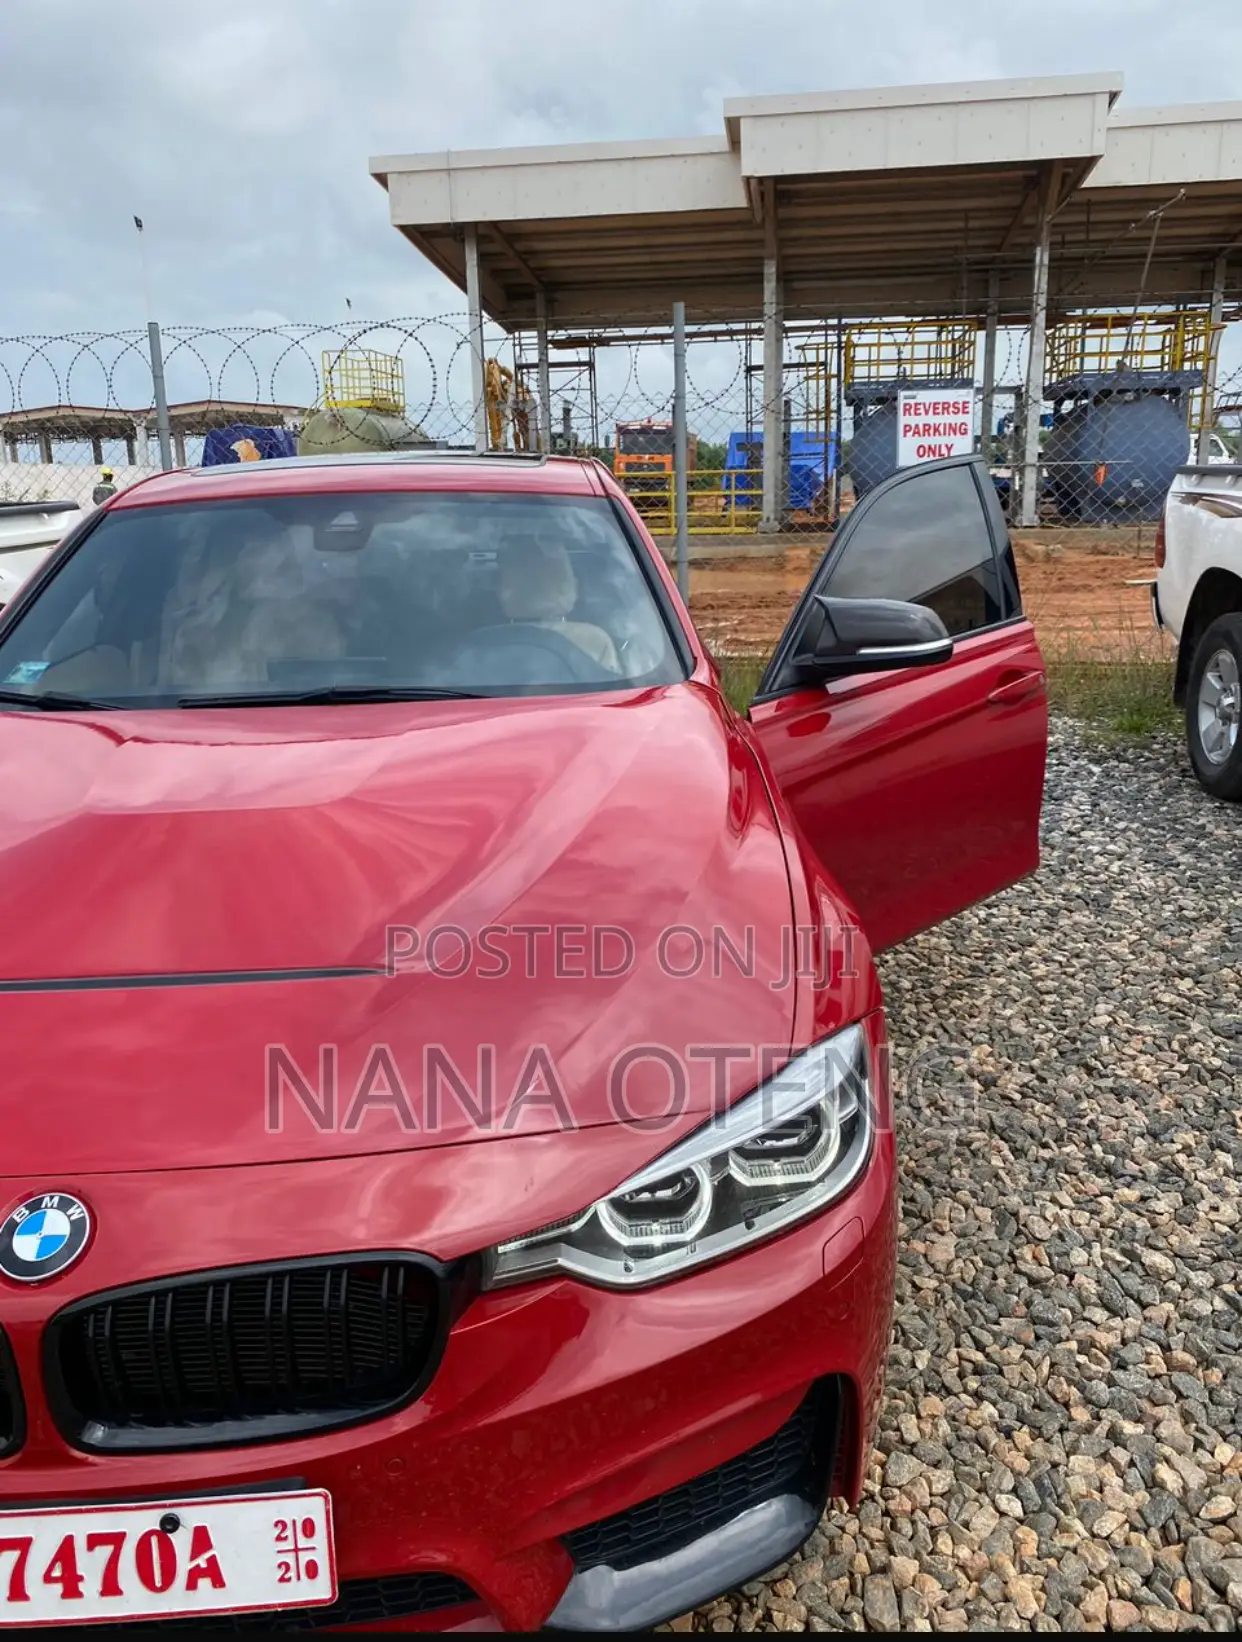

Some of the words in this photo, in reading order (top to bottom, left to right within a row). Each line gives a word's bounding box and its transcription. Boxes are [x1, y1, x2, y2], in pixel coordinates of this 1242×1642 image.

[902, 400, 970, 417] REVERSE
[902, 422, 969, 438] PARKING
[916, 443, 954, 458] ONLY
[12, 1195, 85, 1223] BMW
